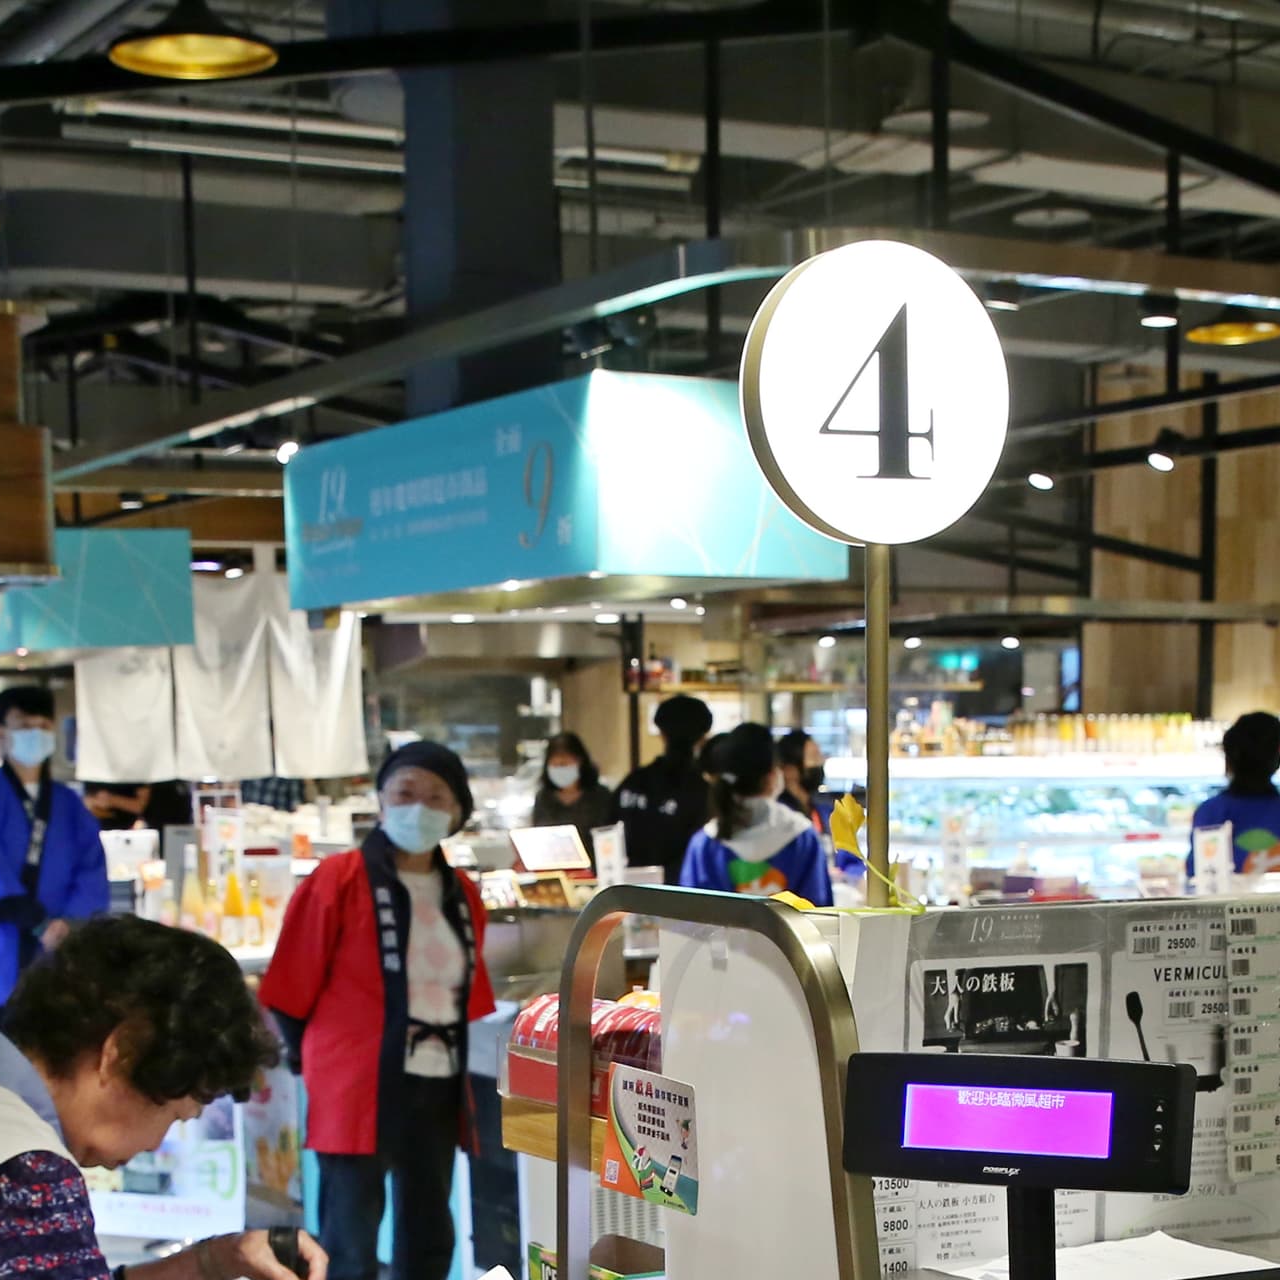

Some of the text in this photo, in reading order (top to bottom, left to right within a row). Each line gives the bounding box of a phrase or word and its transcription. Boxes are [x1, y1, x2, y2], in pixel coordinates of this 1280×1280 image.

[819, 302, 934, 479] 4
[1167, 938, 1196, 949] 29500
[957, 1090, 1066, 1109] 歡迎光臨微風超市
[883, 1219, 909, 1231] 9800
[883, 1261, 908, 1274] 1400
